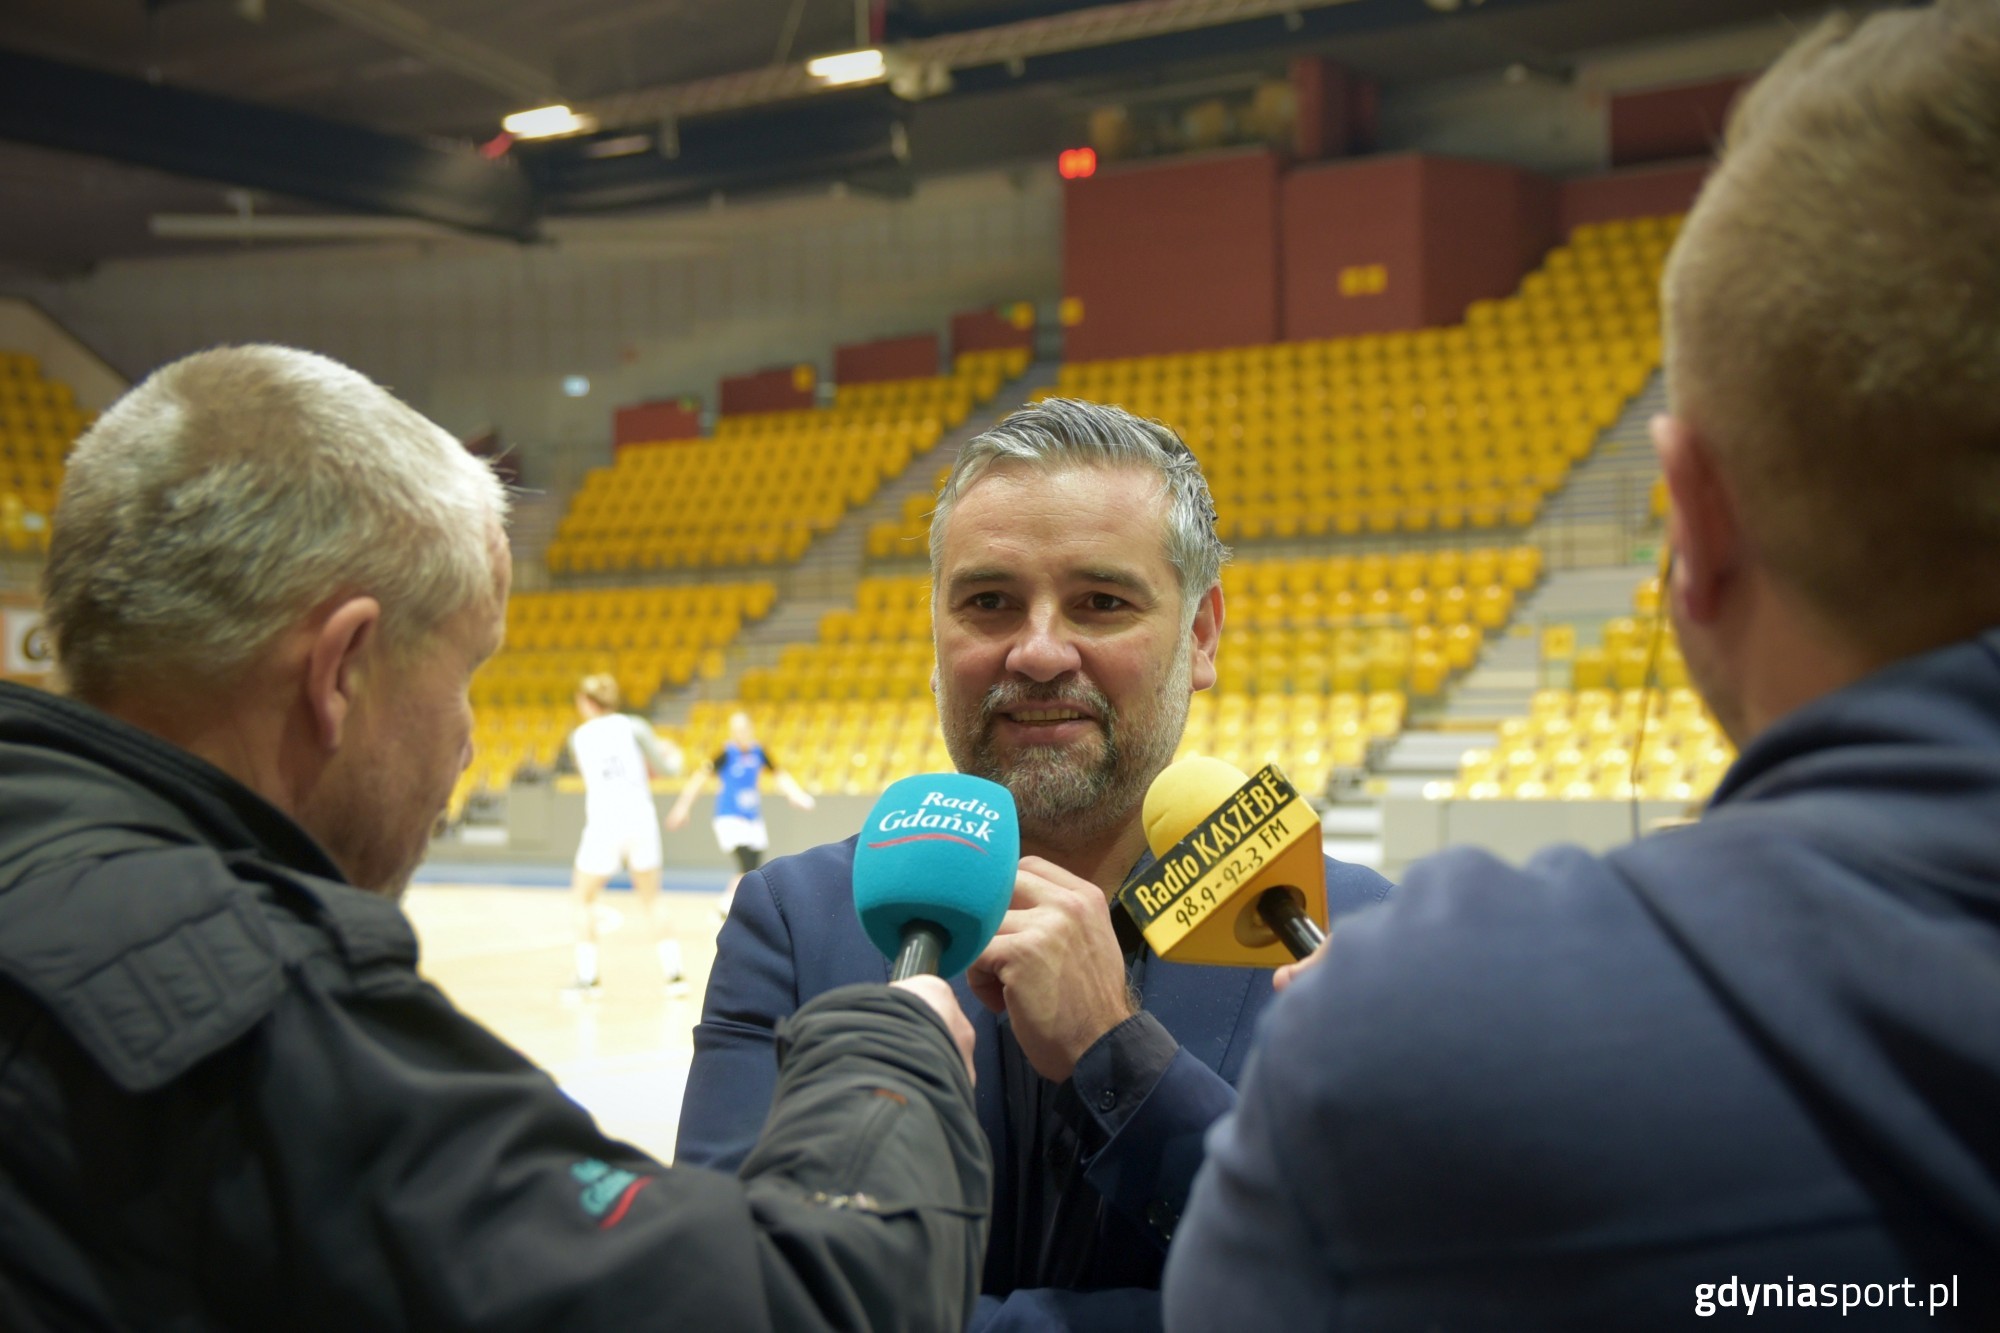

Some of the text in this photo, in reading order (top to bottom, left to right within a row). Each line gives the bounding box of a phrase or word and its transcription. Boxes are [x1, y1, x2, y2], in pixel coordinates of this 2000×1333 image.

[921, 791, 1000, 821] Radio
[878, 807, 996, 843] Gdańsk
[1258, 817, 1291, 850] FM
[1134, 770, 1289, 917] Radio KASZËBË
